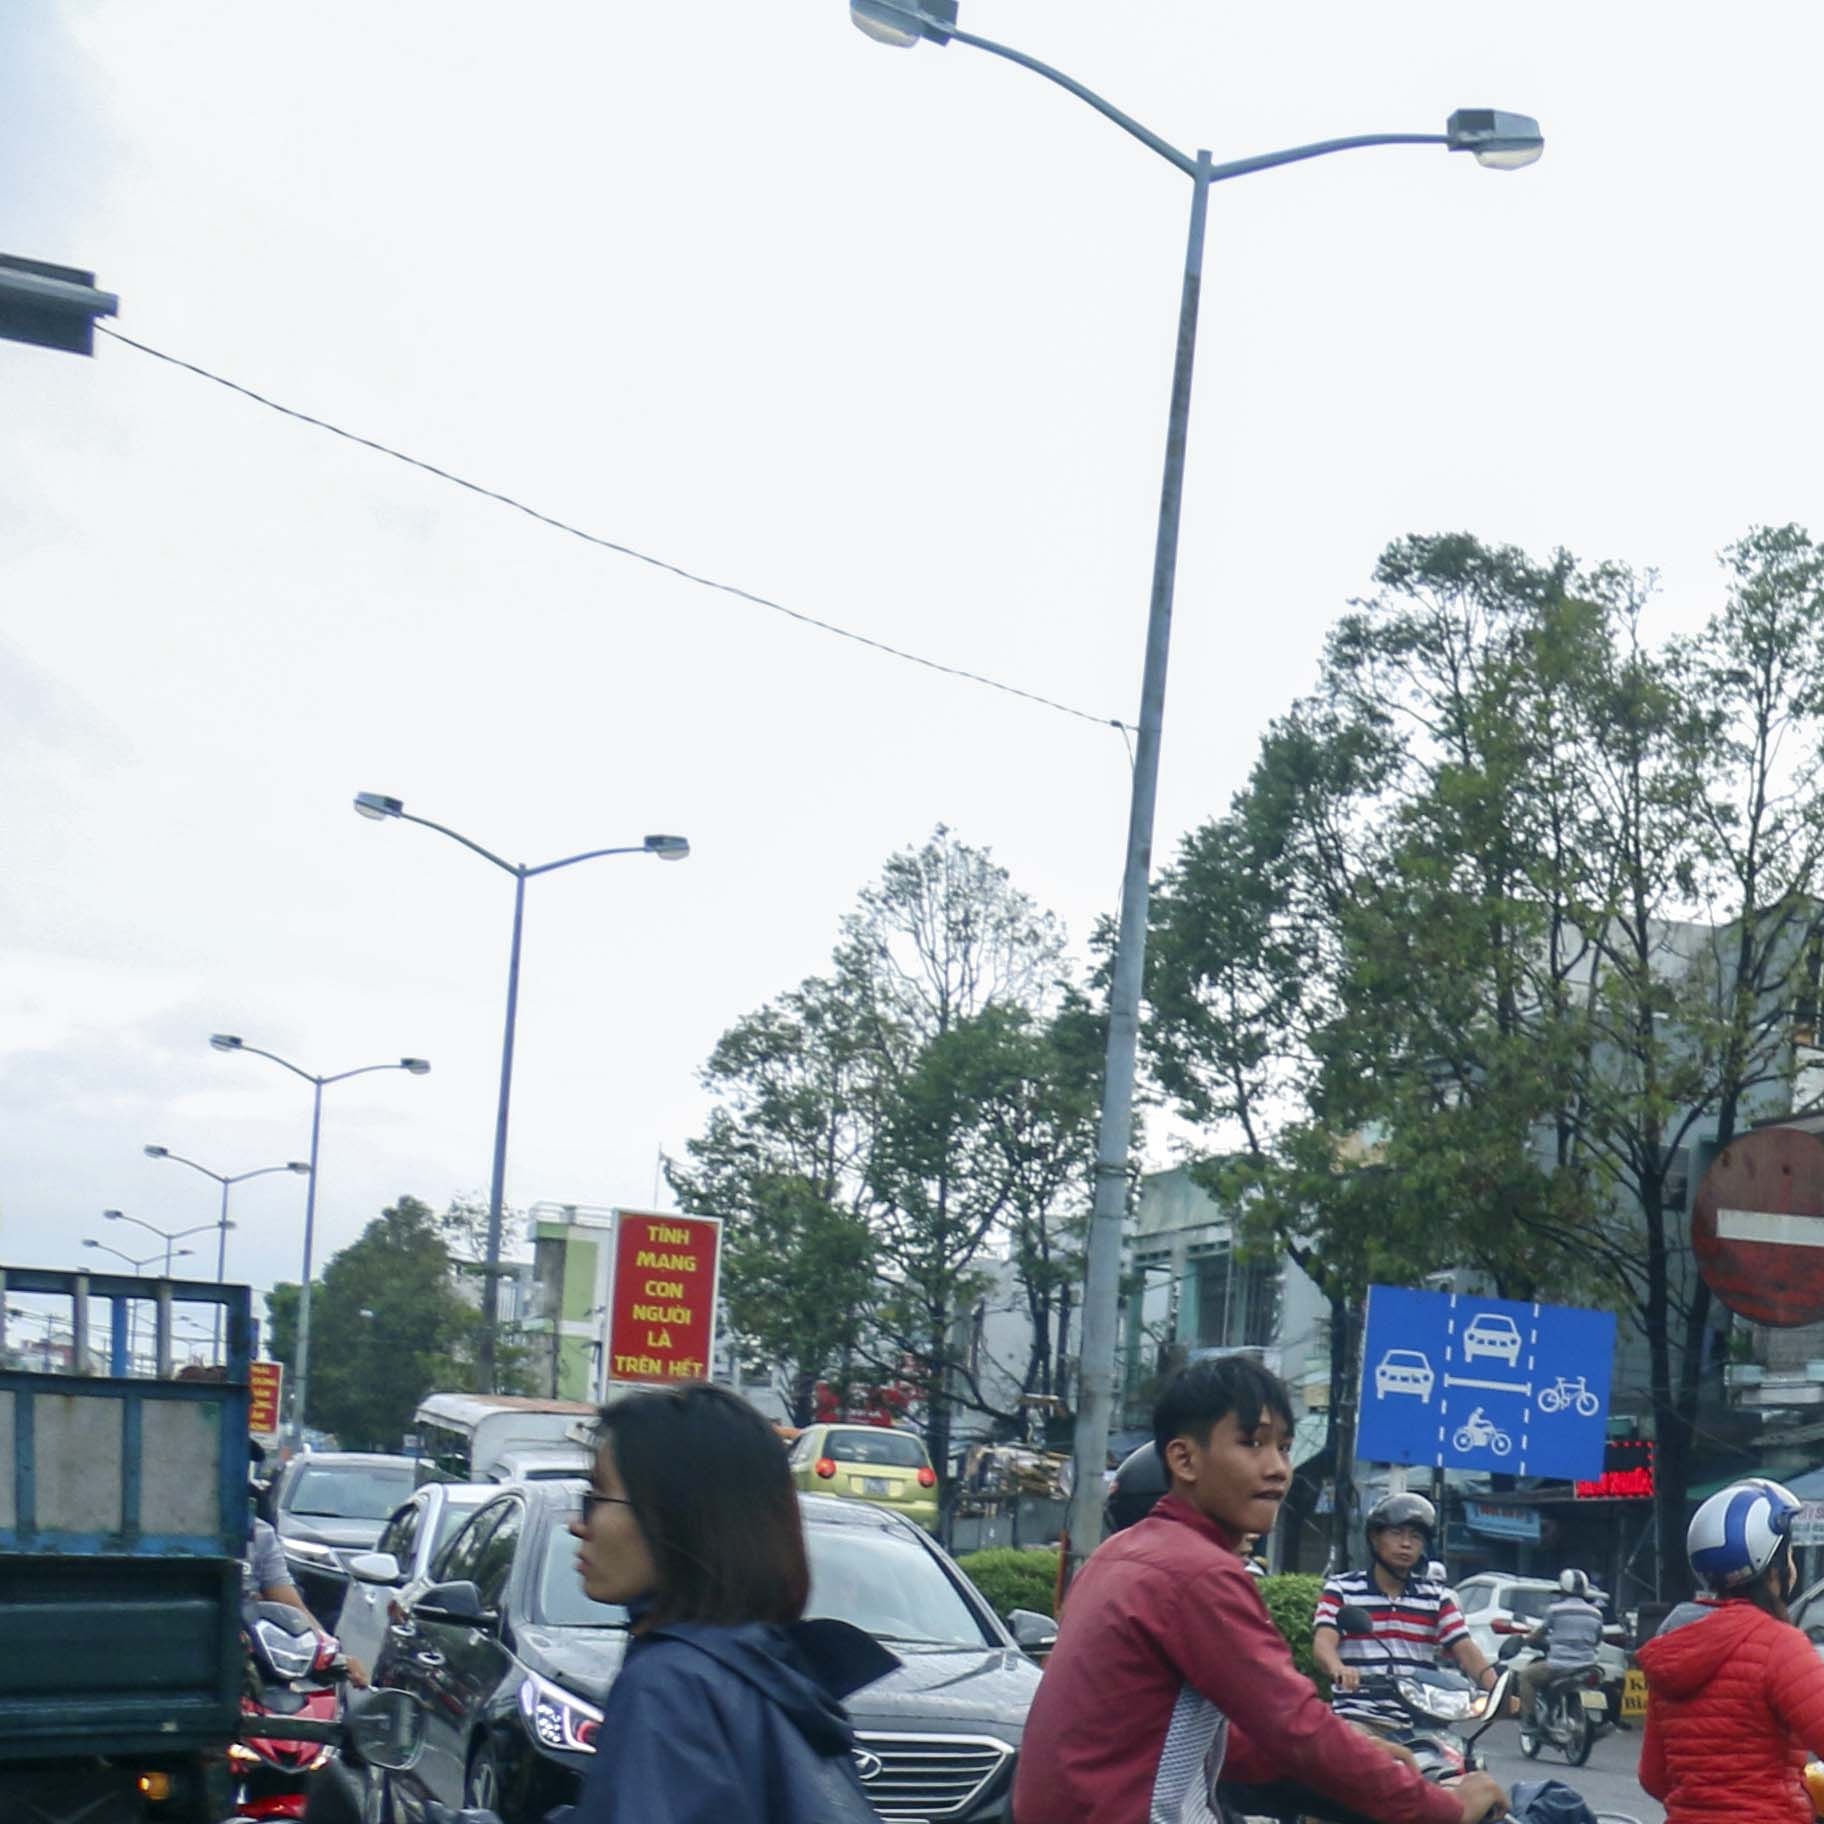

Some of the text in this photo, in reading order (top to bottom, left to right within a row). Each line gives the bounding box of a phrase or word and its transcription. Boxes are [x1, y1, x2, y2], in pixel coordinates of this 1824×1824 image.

[647, 1223, 690, 1245] TÍNH
[636, 1251, 697, 1274] MẠNG
[644, 1280, 683, 1299] CON
[633, 1304, 692, 1325] NGƯỜI
[647, 1328, 672, 1349] LÀ
[615, 1353, 703, 1378] TRÊN HẾT
